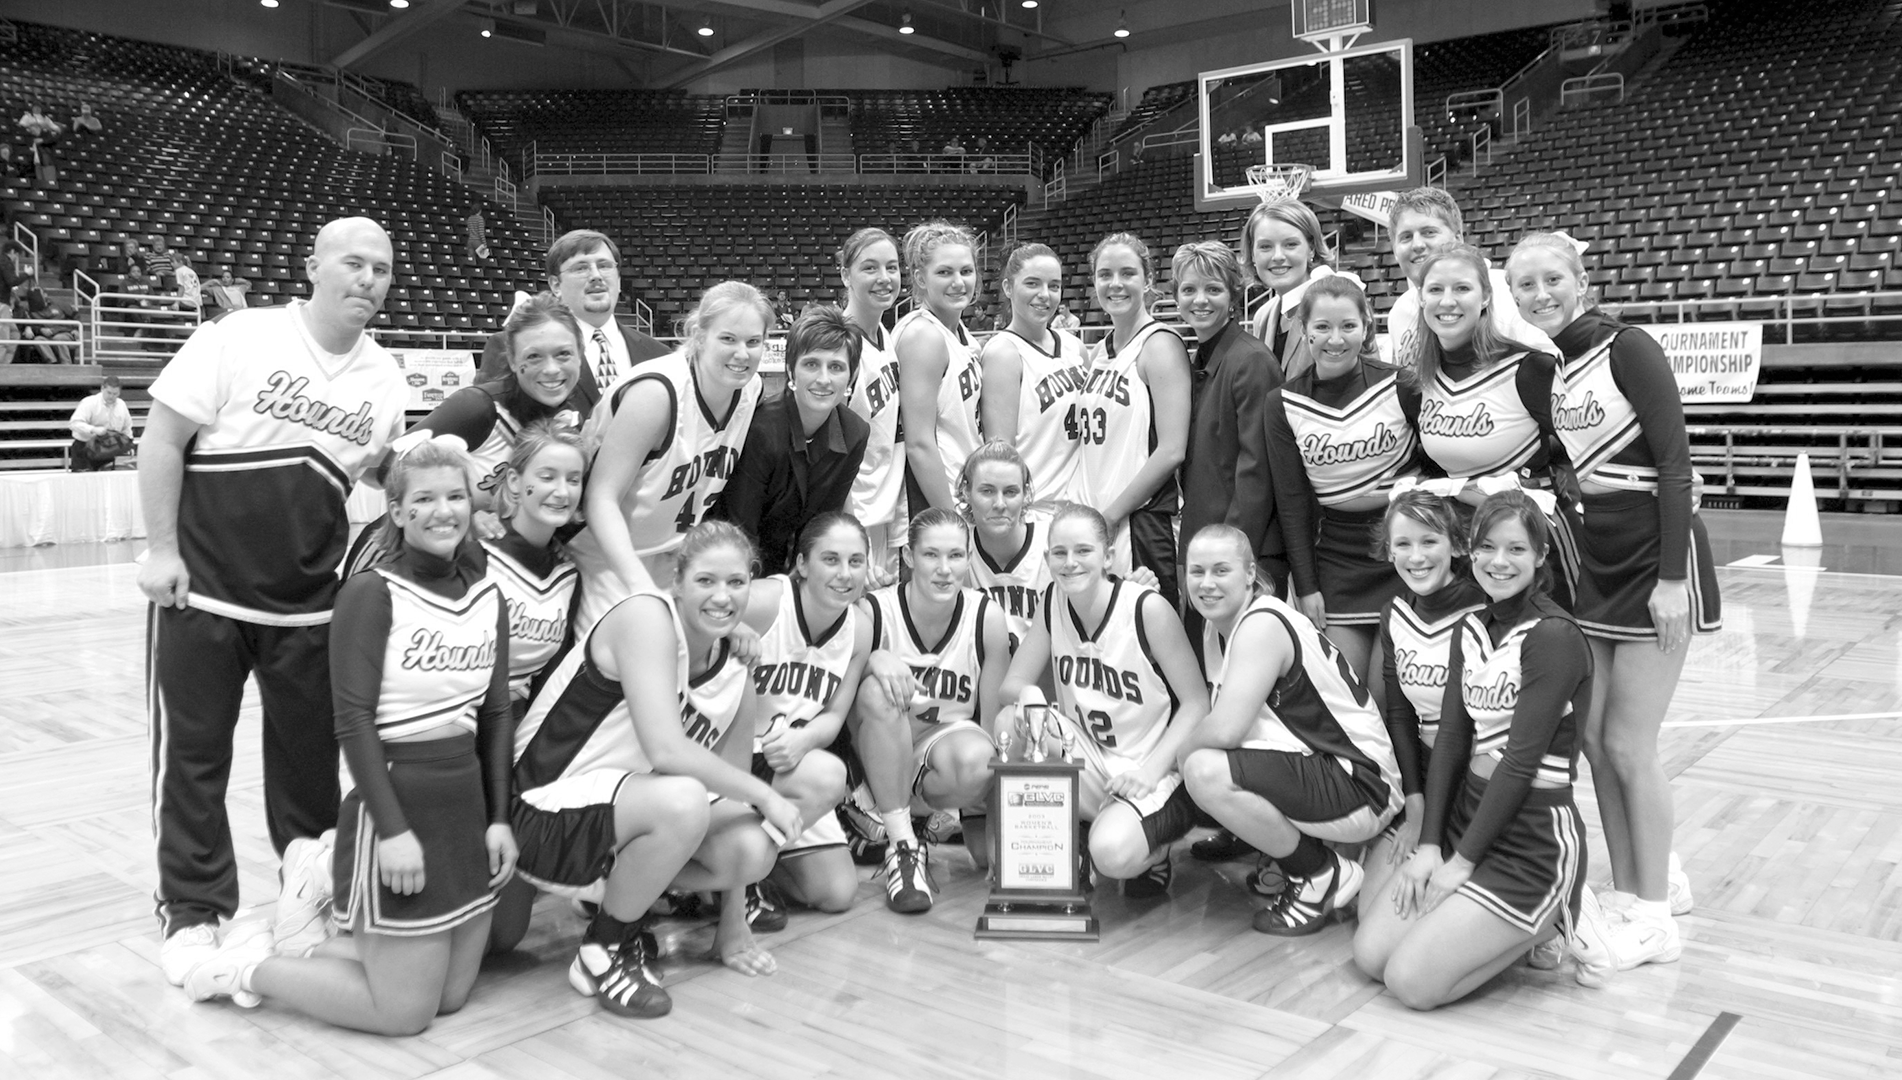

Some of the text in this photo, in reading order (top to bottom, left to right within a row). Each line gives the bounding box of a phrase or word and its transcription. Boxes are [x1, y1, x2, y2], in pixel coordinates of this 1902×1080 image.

[1660, 330, 1749, 351] OURNAMENT
[253, 369, 374, 447] Hounds
[1035, 365, 1086, 415] HOUN
[1418, 398, 1495, 438] Hounds
[1303, 422, 1398, 466] Hounds
[674, 491, 721, 533] 4
[977, 585, 1041, 620] UND
[753, 661, 842, 706] HOUND
[1055, 654, 1144, 706] OUNDS
[1396, 648, 1449, 688] Houn
[1023, 792, 1064, 802] GLVC
[1011, 842, 1064, 851] CHAMPION
[1019, 864, 1054, 875] GLVC
